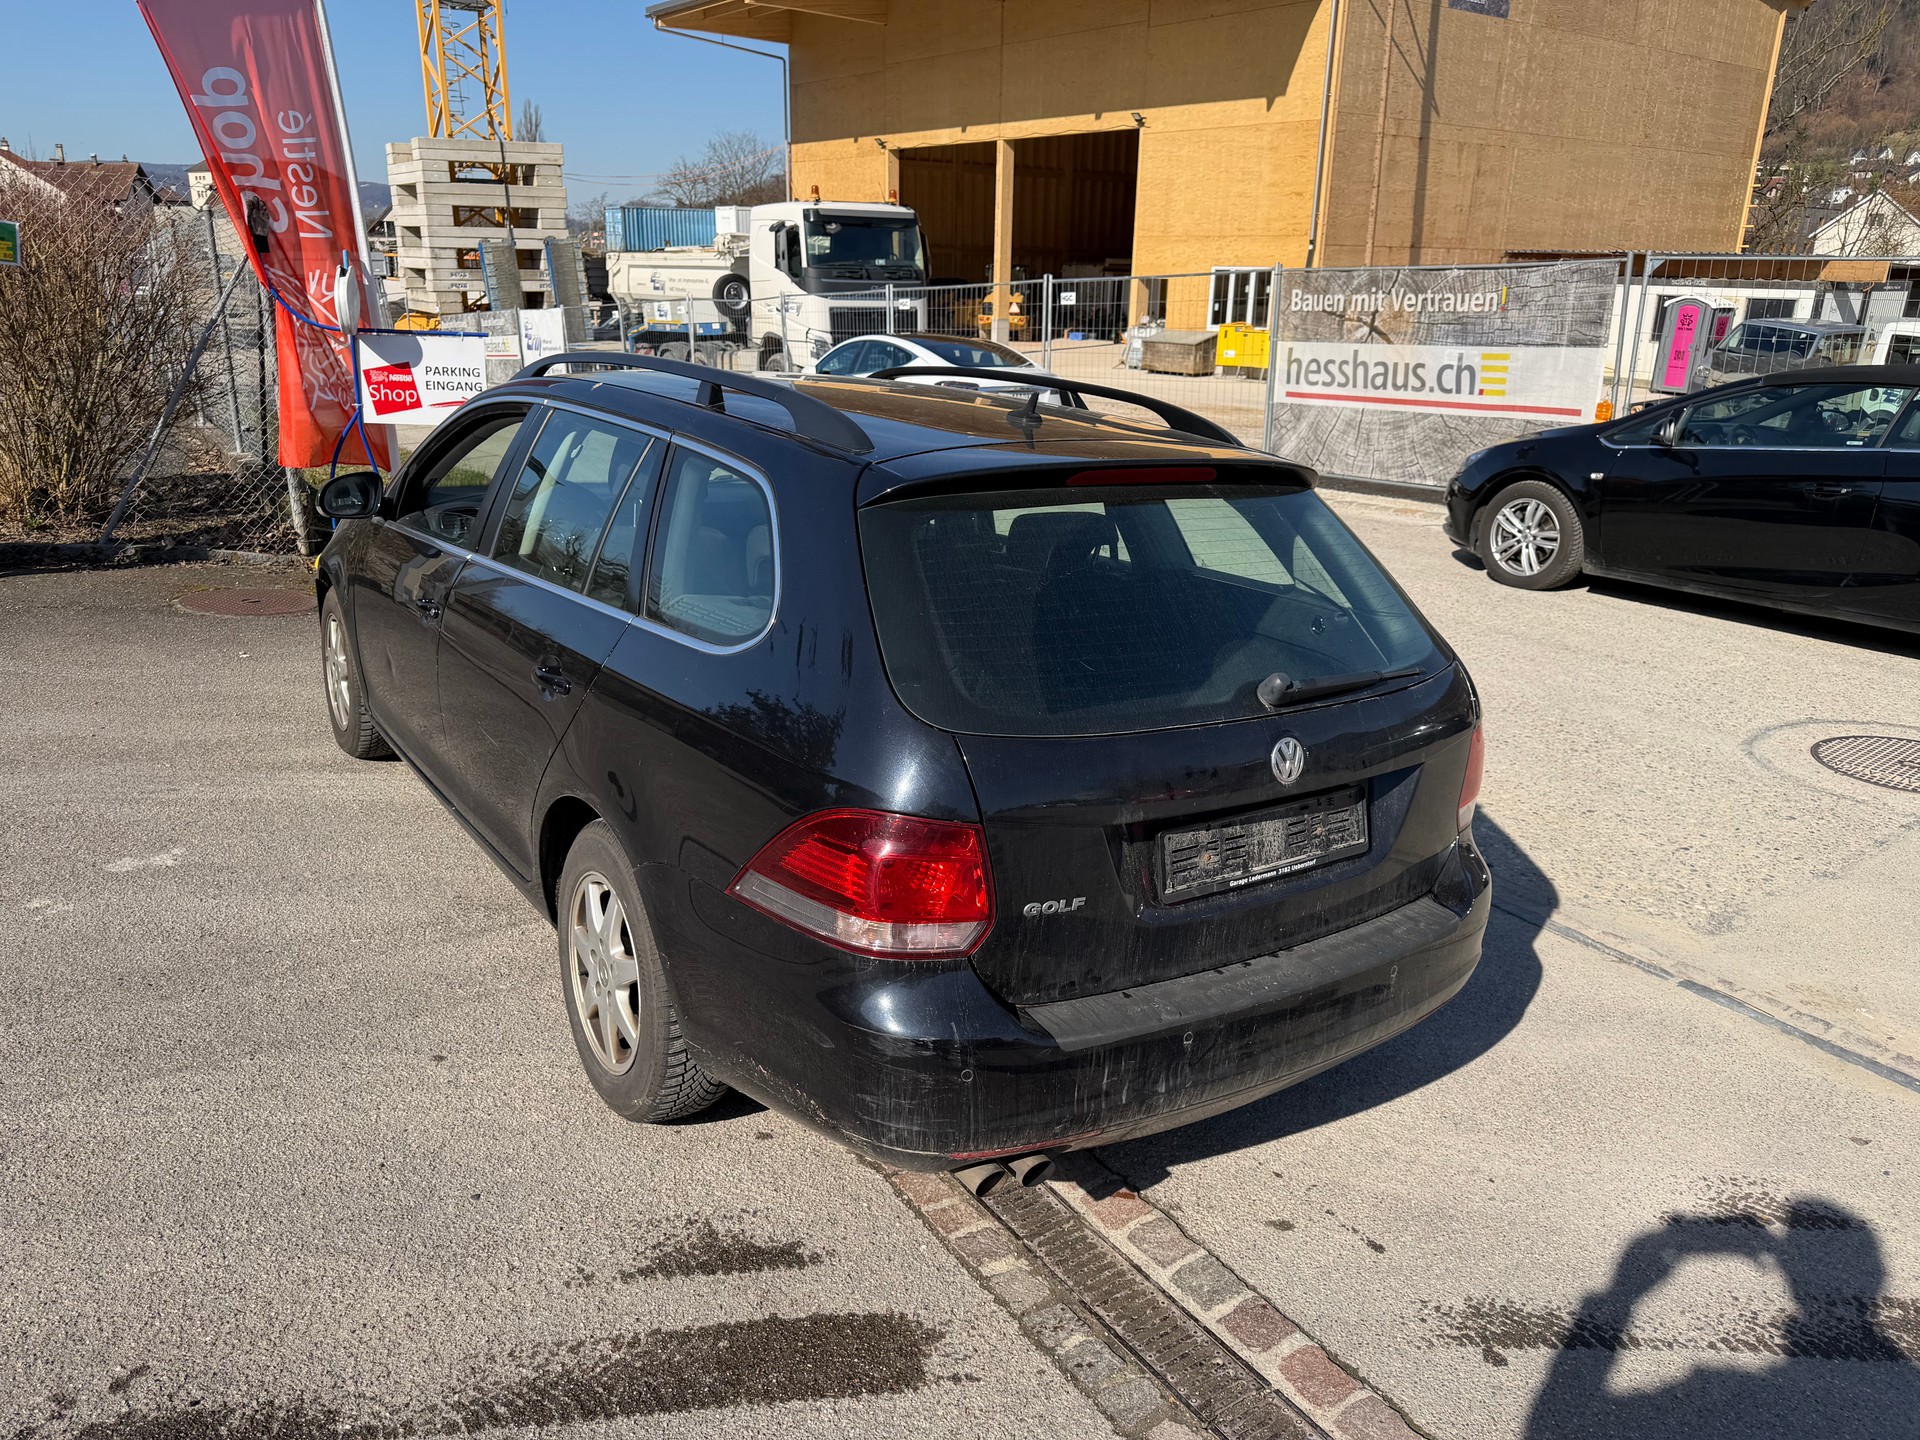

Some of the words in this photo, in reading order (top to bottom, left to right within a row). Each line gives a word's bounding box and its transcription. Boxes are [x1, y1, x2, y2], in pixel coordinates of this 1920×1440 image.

[1291, 288, 1345, 312] Bauen
[1350, 287, 1385, 312] mit
[1392, 285, 1508, 312] Vertrauen!
[425, 366, 481, 378] PARKING
[1285, 347, 1477, 396] hesshaus.ch
[369, 384, 418, 406] Shop
[426, 380, 483, 393] EINGANG
[1229, 878, 1248, 887] Garage
[1248, 870, 1277, 882] Ledermann
[1278, 865, 1291, 875] 3182
[1291, 859, 1317, 871] Ueberstorf
[1023, 897, 1086, 917] GOLF
